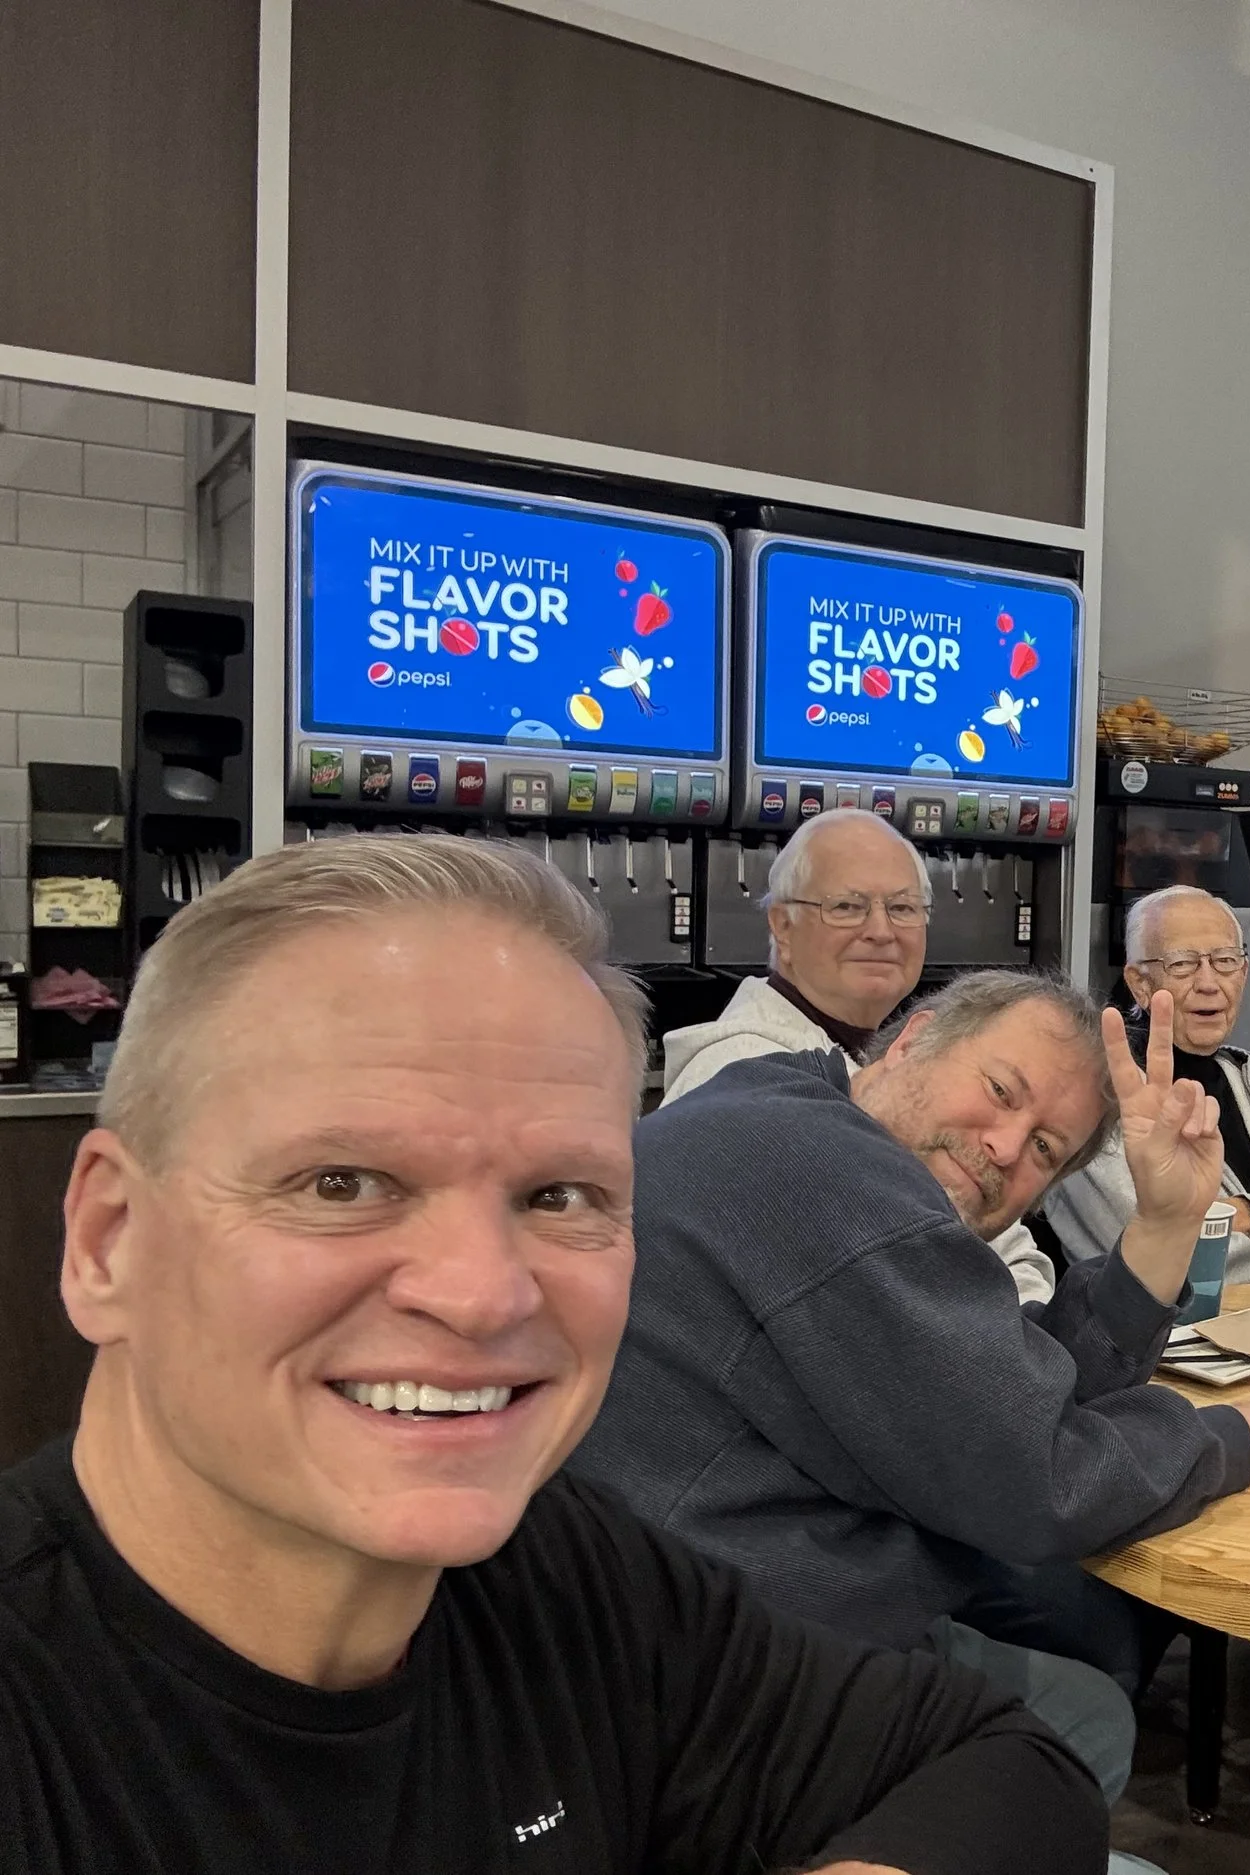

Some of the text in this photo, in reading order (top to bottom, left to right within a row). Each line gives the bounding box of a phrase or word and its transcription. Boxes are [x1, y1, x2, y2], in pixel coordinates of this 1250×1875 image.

[369, 537, 569, 583] MIX IT UP WITH
[370, 566, 569, 626] FLAVOR
[809, 596, 962, 634] MIX IT UP WITH
[368, 611, 539, 663] SHOTS
[808, 621, 961, 671] FLAVOR
[397, 669, 452, 687] pepsi
[807, 659, 937, 704] SHOTS
[828, 711, 871, 726] pepsi
